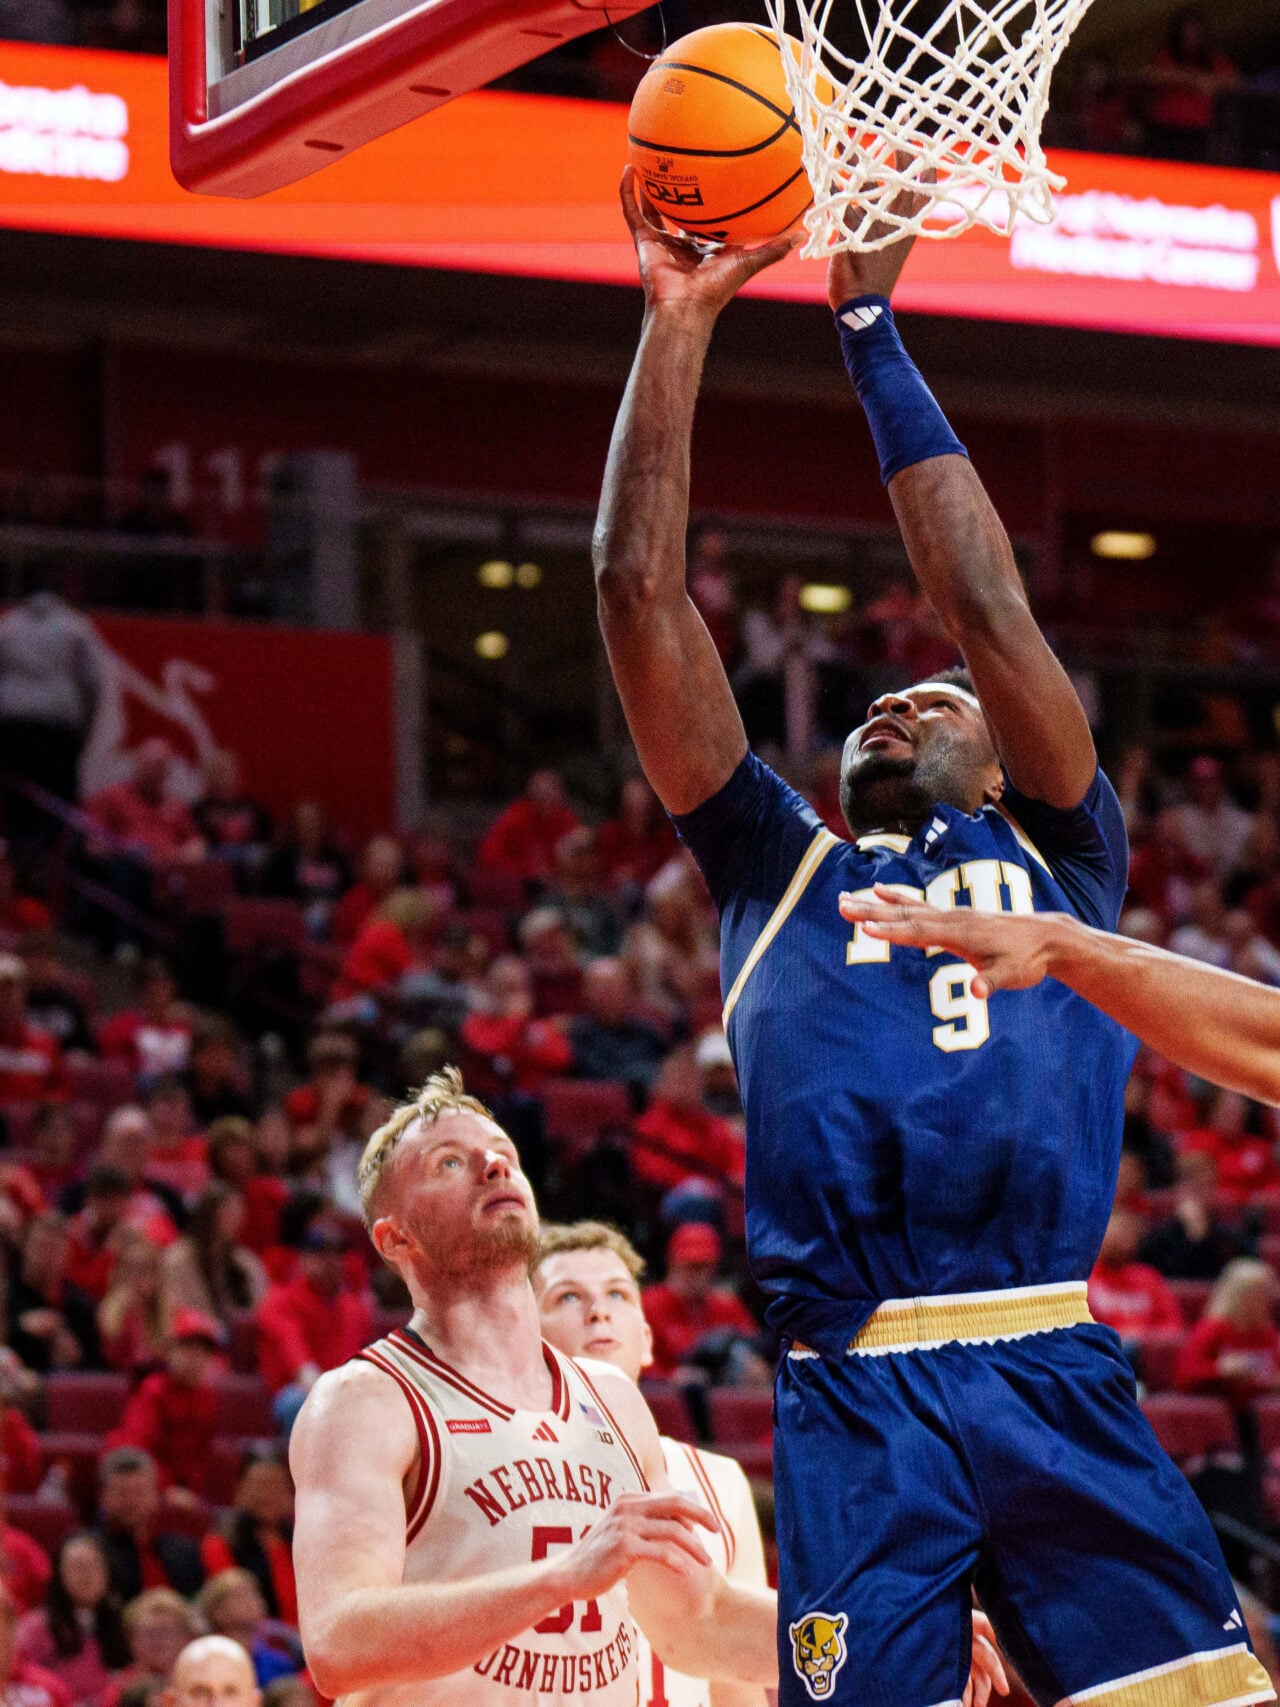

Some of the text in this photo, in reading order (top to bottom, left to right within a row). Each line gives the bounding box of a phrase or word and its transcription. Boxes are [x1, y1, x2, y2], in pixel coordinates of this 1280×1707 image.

[645, 180, 704, 206] PRO
[929, 963, 990, 1053] 9
[464, 1458, 613, 1527] NEBRASK
[474, 1622, 632, 1694] ORNHUSKERS
